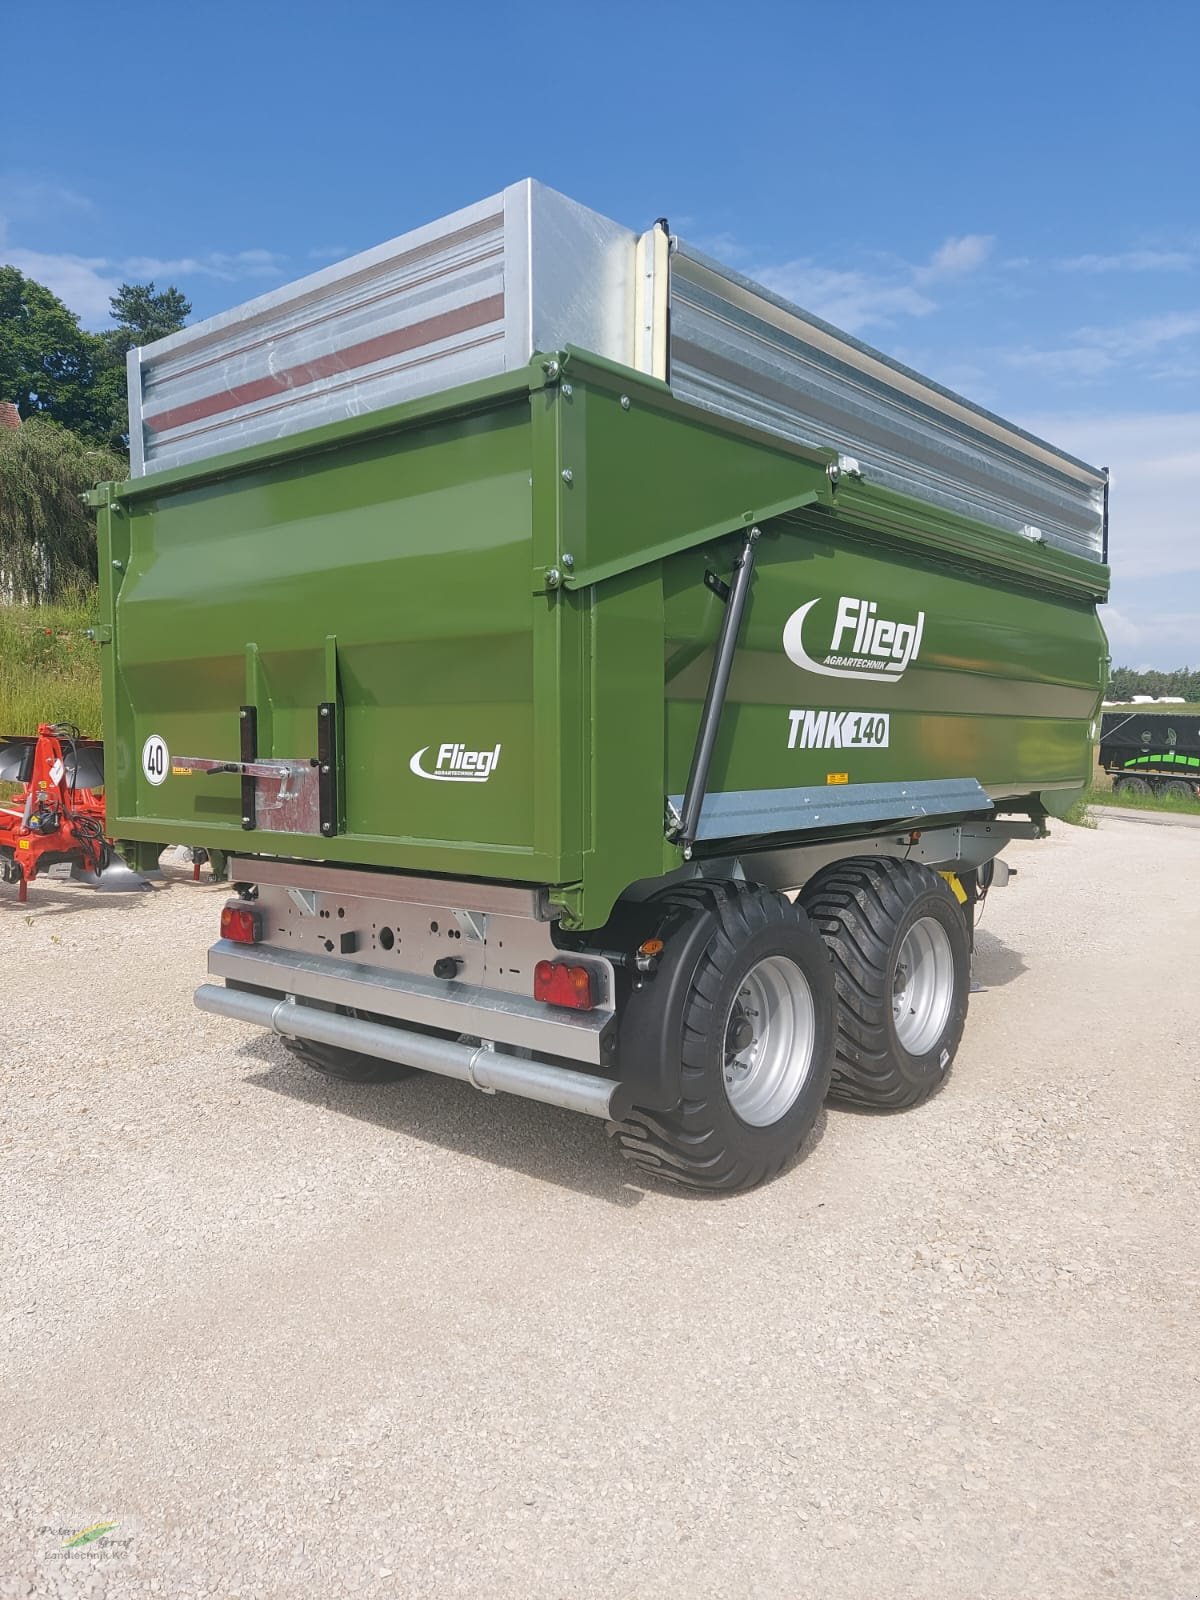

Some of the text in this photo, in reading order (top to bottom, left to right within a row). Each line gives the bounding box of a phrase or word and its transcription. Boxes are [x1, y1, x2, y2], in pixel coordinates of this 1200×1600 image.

[830, 596, 925, 671] Fliegl
[823, 655, 888, 671] AGRARTECHNIK
[787, 709, 886, 749] TMK 140
[147, 744, 163, 776] 40
[436, 743, 501, 777] Fliegl
